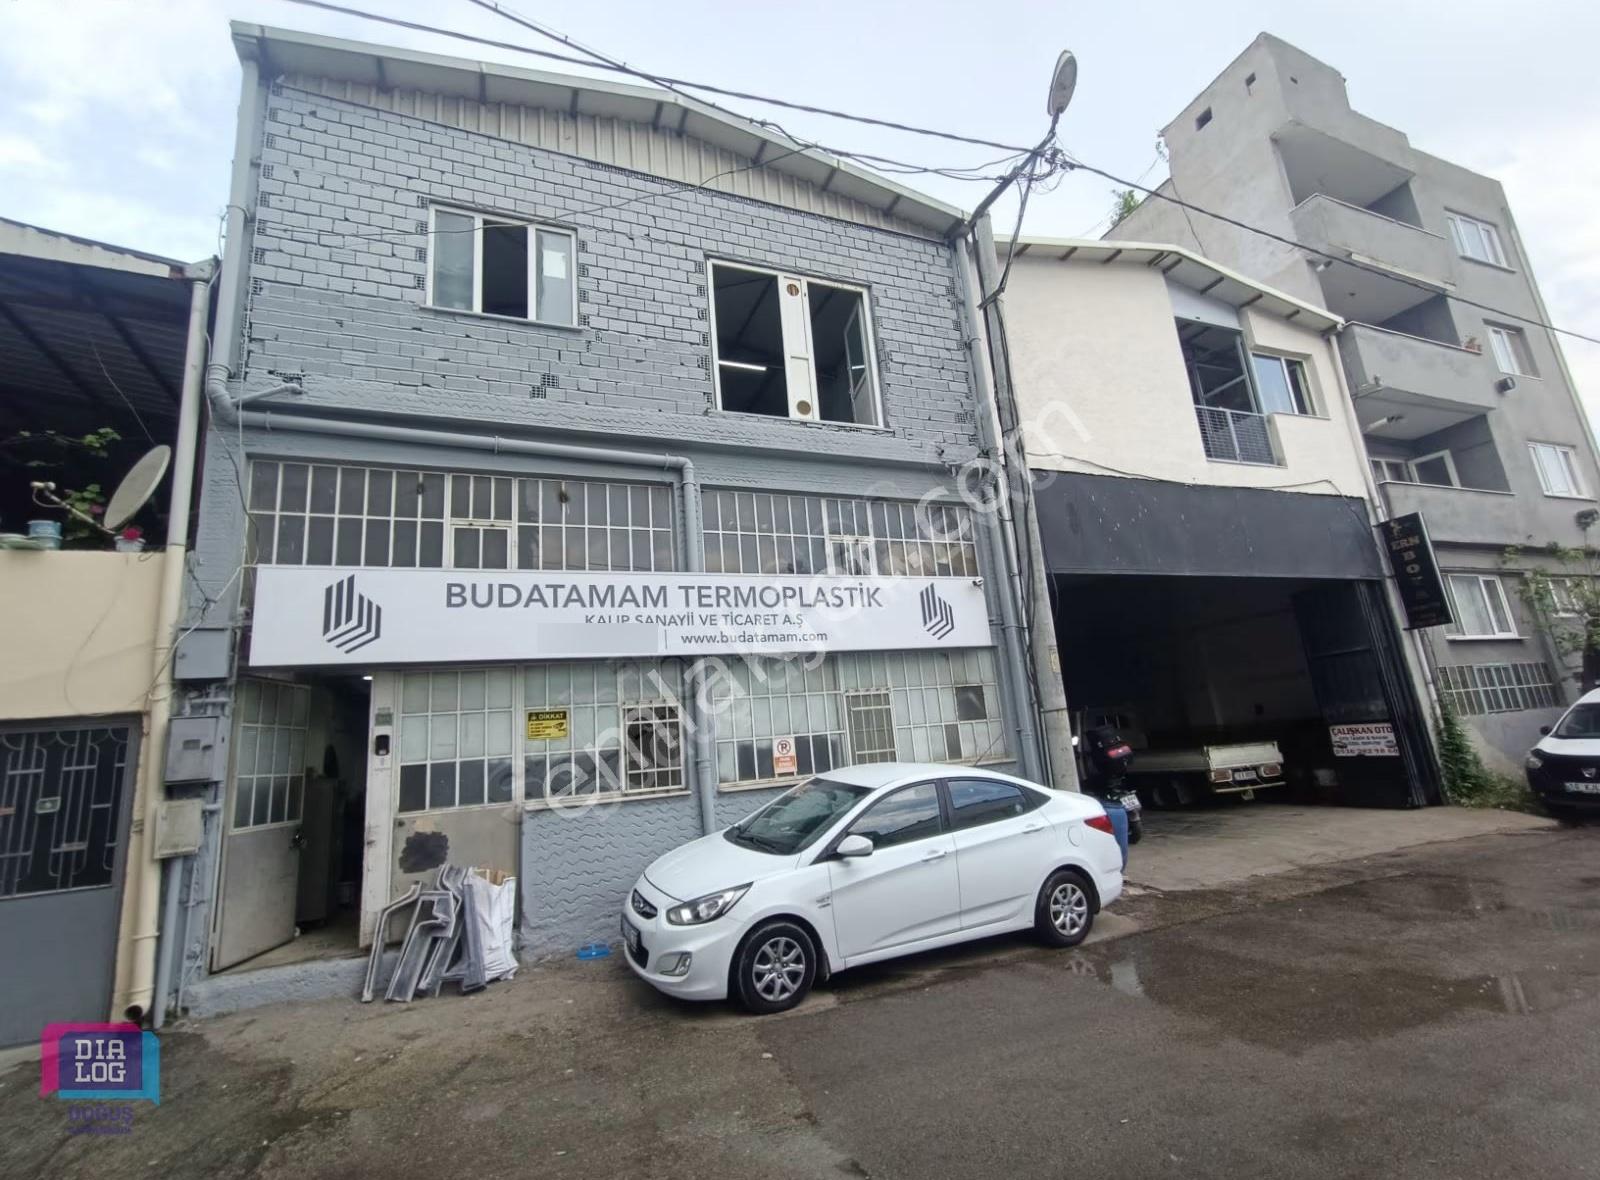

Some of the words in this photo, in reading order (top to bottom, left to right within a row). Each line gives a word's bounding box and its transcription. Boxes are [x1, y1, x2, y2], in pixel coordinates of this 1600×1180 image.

[446, 583, 668, 608] BUDATAMAM
[678, 582, 883, 608] TERMOPLASTİK
[699, 614, 718, 626] VE
[721, 611, 779, 626] TİCARET
[681, 631, 828, 644] www.budatamam.com
[1331, 727, 1374, 736] ÇALIŞKAN
